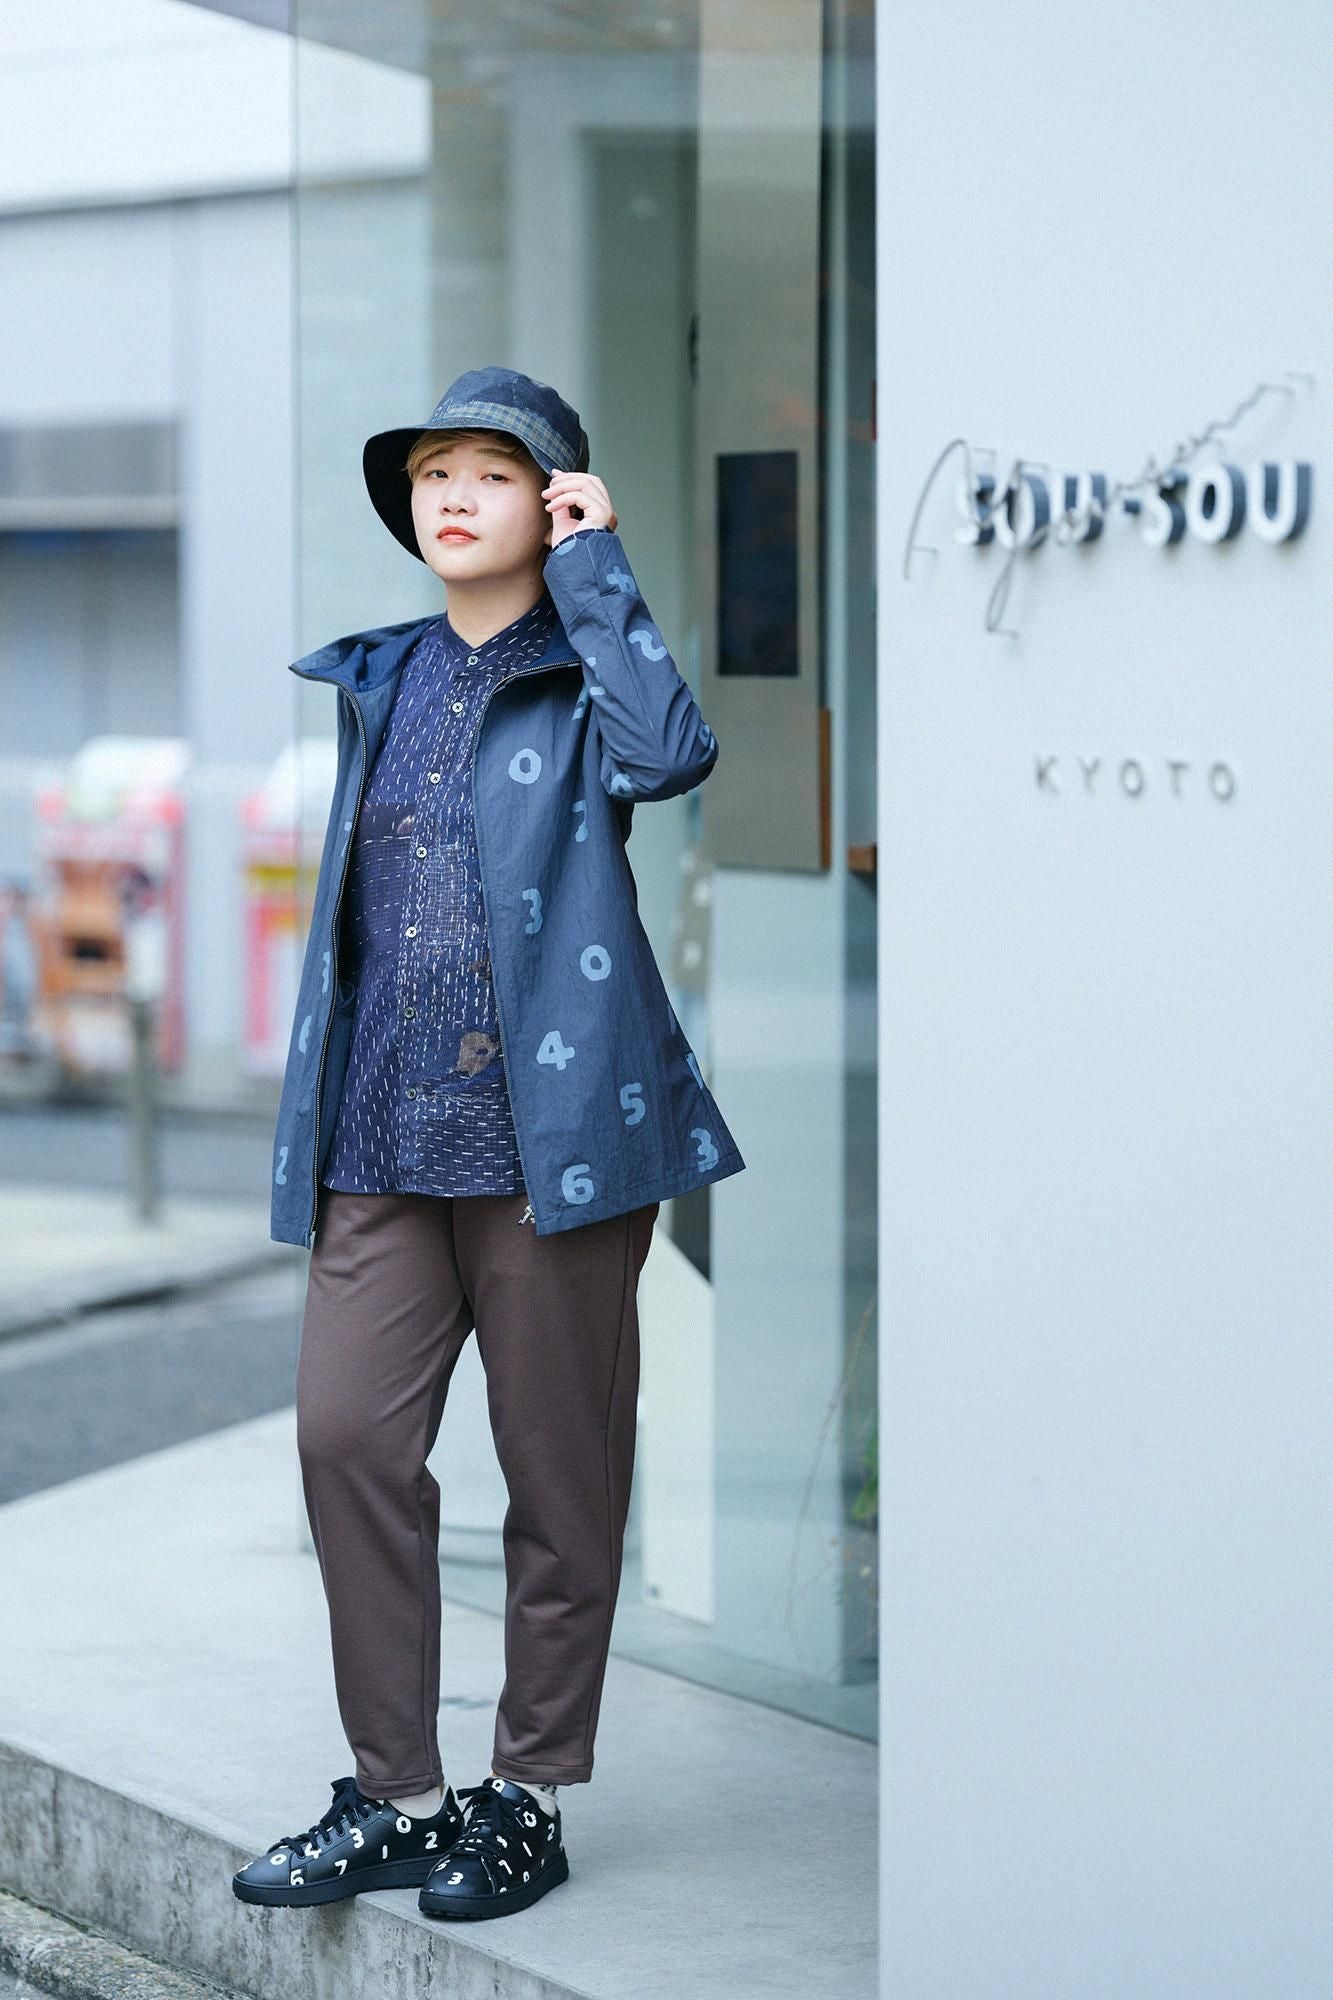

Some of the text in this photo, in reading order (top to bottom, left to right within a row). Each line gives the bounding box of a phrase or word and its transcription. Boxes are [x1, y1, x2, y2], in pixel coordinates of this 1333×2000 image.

[508, 748, 542, 784] 0
[1035, 757, 1237, 803] KYOTO
[522, 888, 544, 935] 3
[580, 944, 612, 982] 0
[536, 1030, 576, 1071] 4
[619, 1082, 646, 1126] 5
[690, 1127, 720, 1173] 3
[561, 1163, 596, 1205] 6
[349, 1827, 365, 1849] 3
[395, 1815, 412, 1834] 0
[424, 1831, 439, 1850] 2
[334, 1858, 348, 1876] 7
[381, 1845, 388, 1860] 1
[447, 1871, 464, 1886] 3
